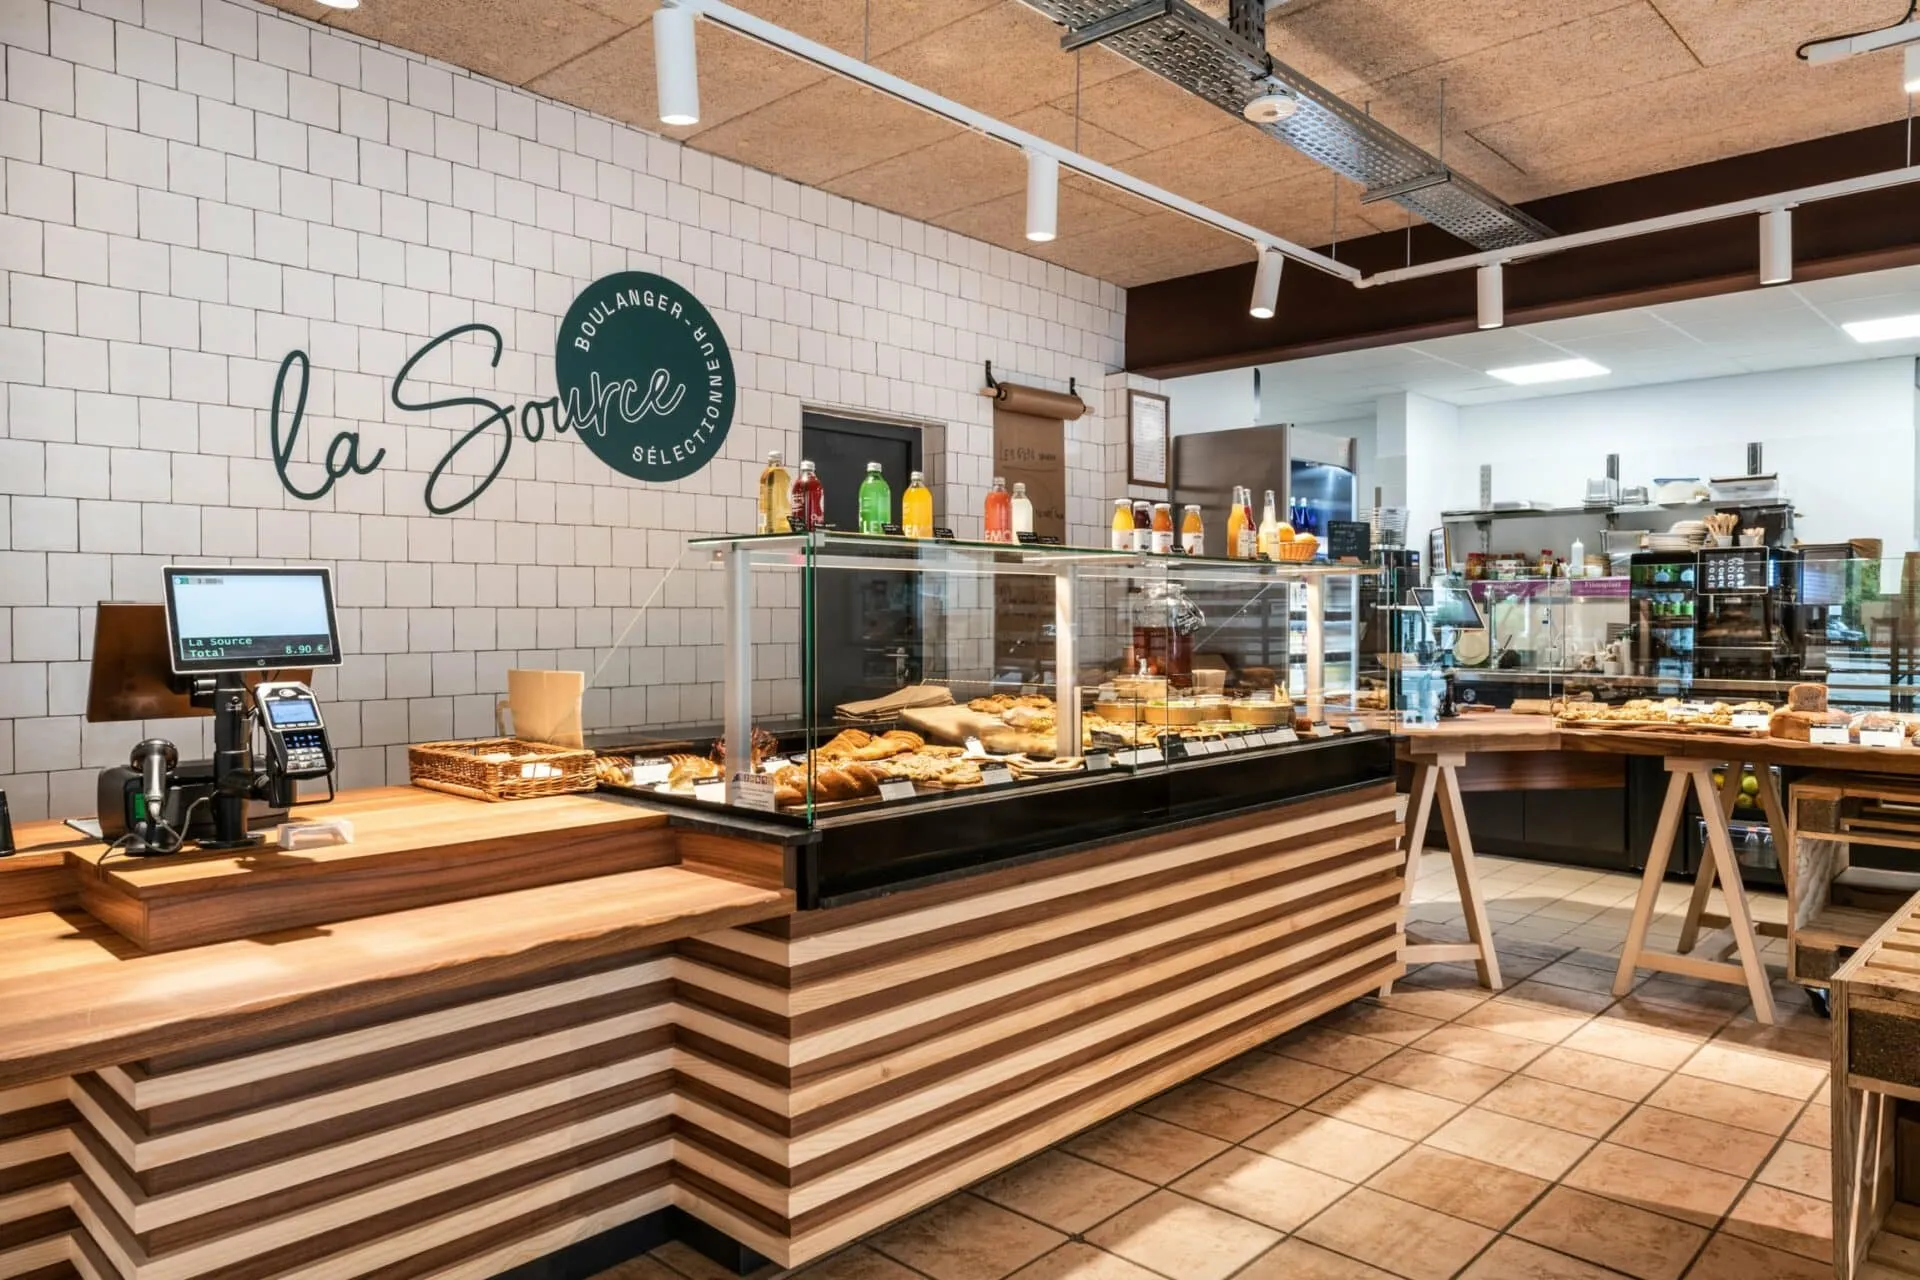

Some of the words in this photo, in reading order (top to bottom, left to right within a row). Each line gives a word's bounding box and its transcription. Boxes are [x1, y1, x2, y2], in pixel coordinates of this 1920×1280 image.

[271, 349, 386, 500] la
[391, 323, 686, 515] Source
[632, 326, 723, 465] SÉLECTIONNEUR
[190, 648, 225, 658] Total
[285, 645, 312, 655] 8.90
[210, 637, 253, 646] Source
